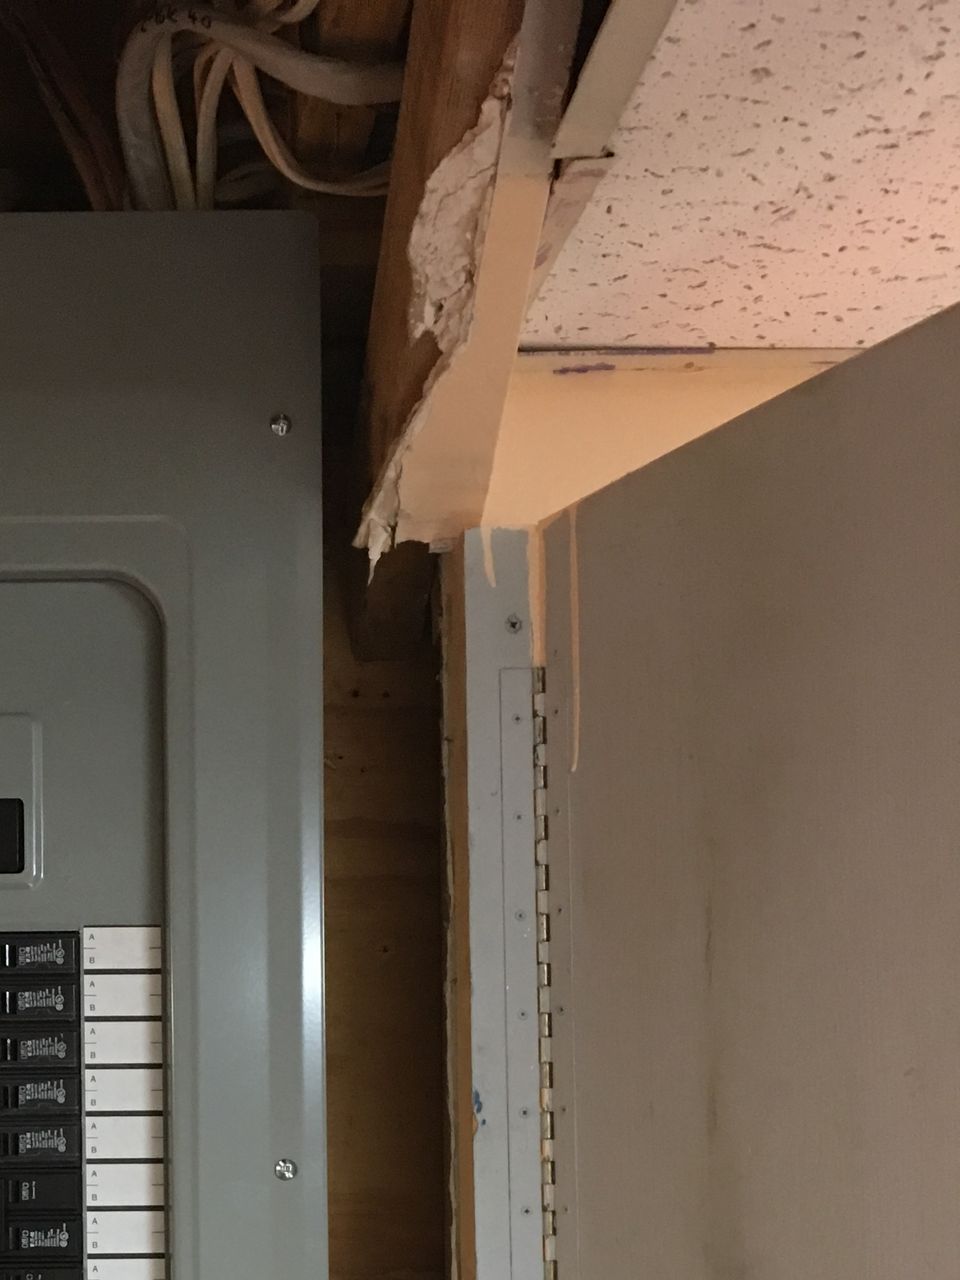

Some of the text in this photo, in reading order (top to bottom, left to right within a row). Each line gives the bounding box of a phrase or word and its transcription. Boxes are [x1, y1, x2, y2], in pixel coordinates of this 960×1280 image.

[88, 933, 95, 941] A
[88, 956, 96, 964] B
[89, 1004, 96, 1012] B
[90, 1051, 96, 1059] B
